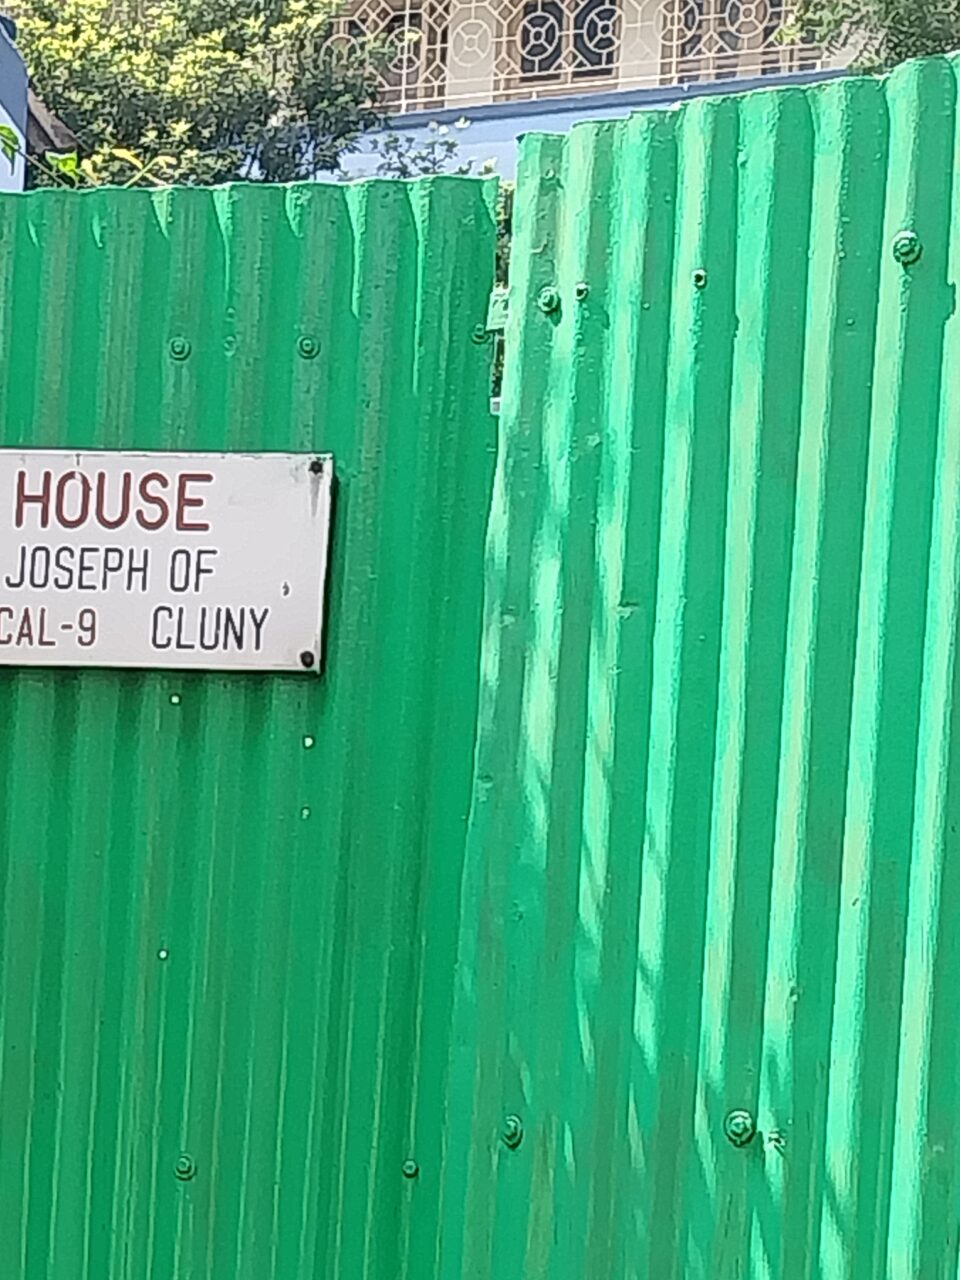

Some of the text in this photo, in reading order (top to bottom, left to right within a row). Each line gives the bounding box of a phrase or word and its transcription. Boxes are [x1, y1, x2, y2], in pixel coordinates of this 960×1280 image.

[14, 470, 214, 532] HOUSE
[5, 545, 149, 592] JOSEPH
[169, 549, 218, 593] OF
[151, 605, 269, 651] CLUNY
